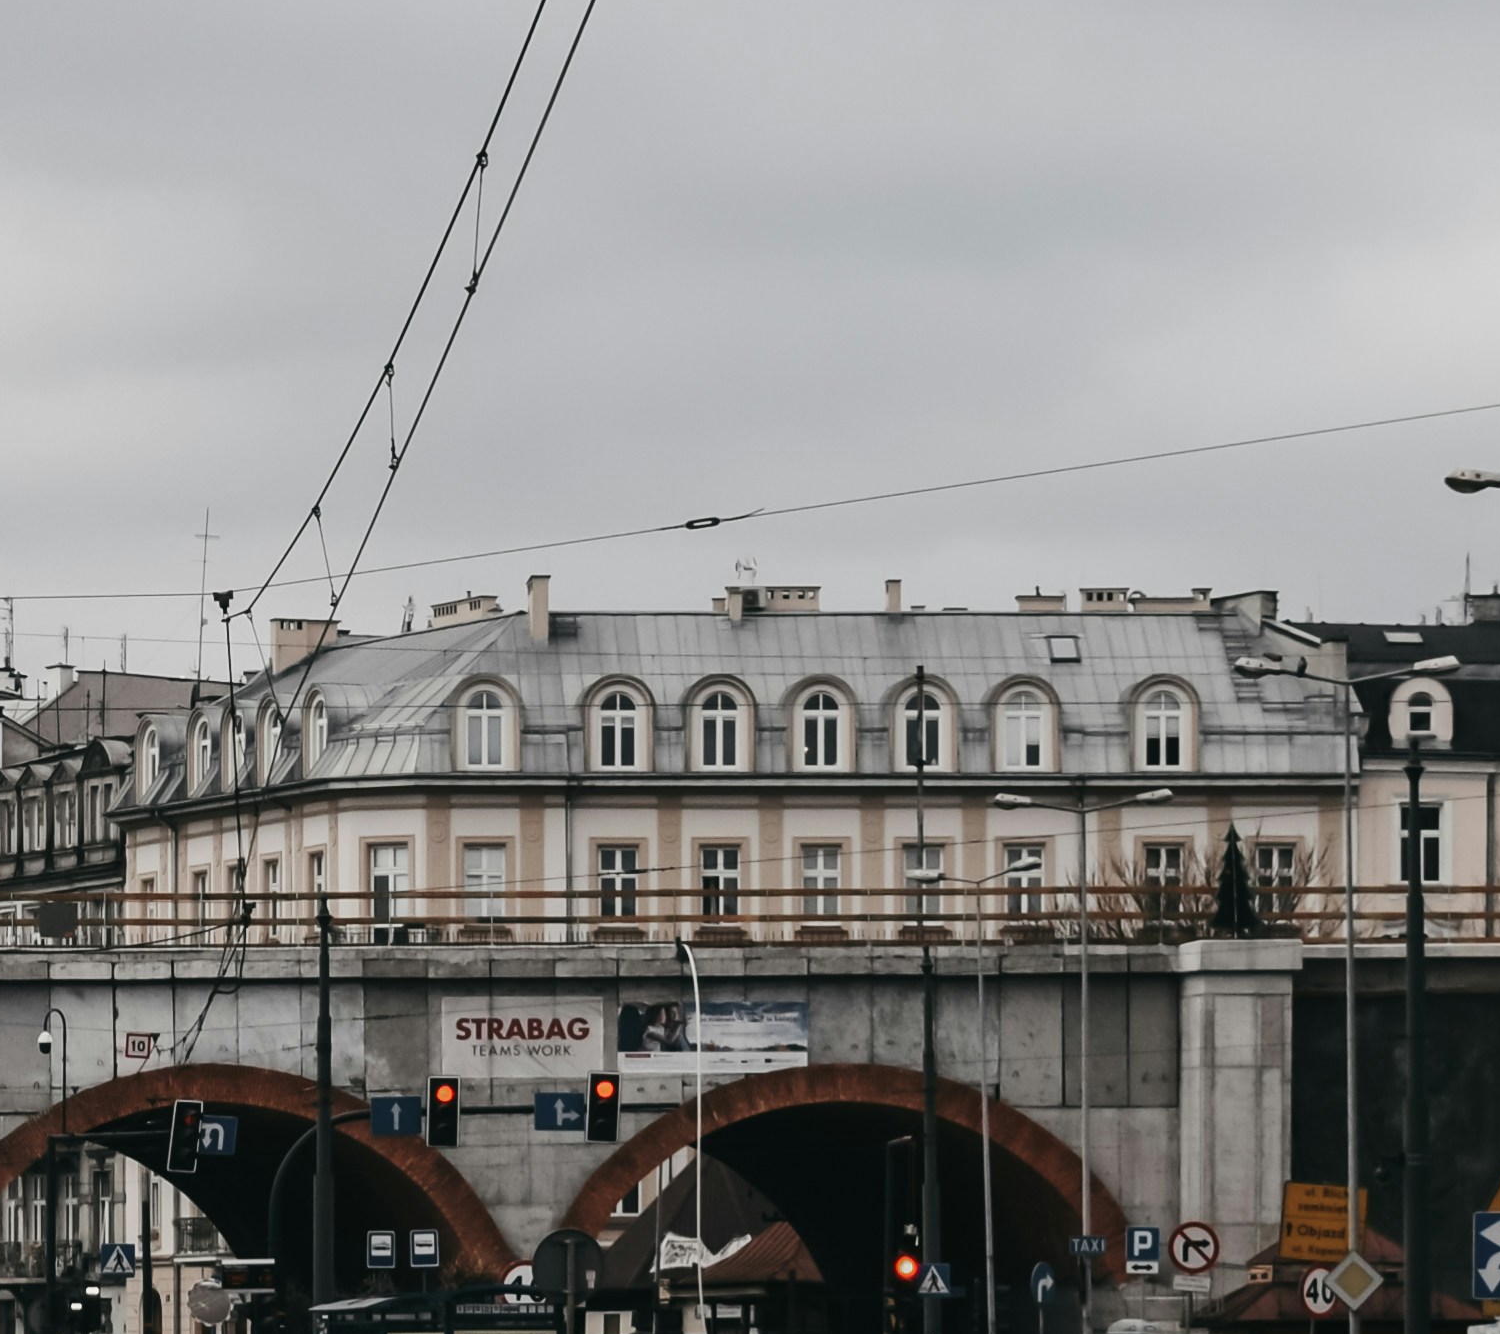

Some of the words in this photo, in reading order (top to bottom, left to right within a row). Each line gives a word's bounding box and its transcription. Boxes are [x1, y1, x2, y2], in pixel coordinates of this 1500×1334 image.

[455, 1017, 590, 1040] STRABAG
[131, 1040, 146, 1052] 10
[472, 1045, 521, 1056] TEAMS
[1297, 1225, 1345, 1240] Objazd
[1072, 1238, 1105, 1252] TAXI
[1133, 1230, 1153, 1257] P
[1306, 1278, 1335, 1305] 40
